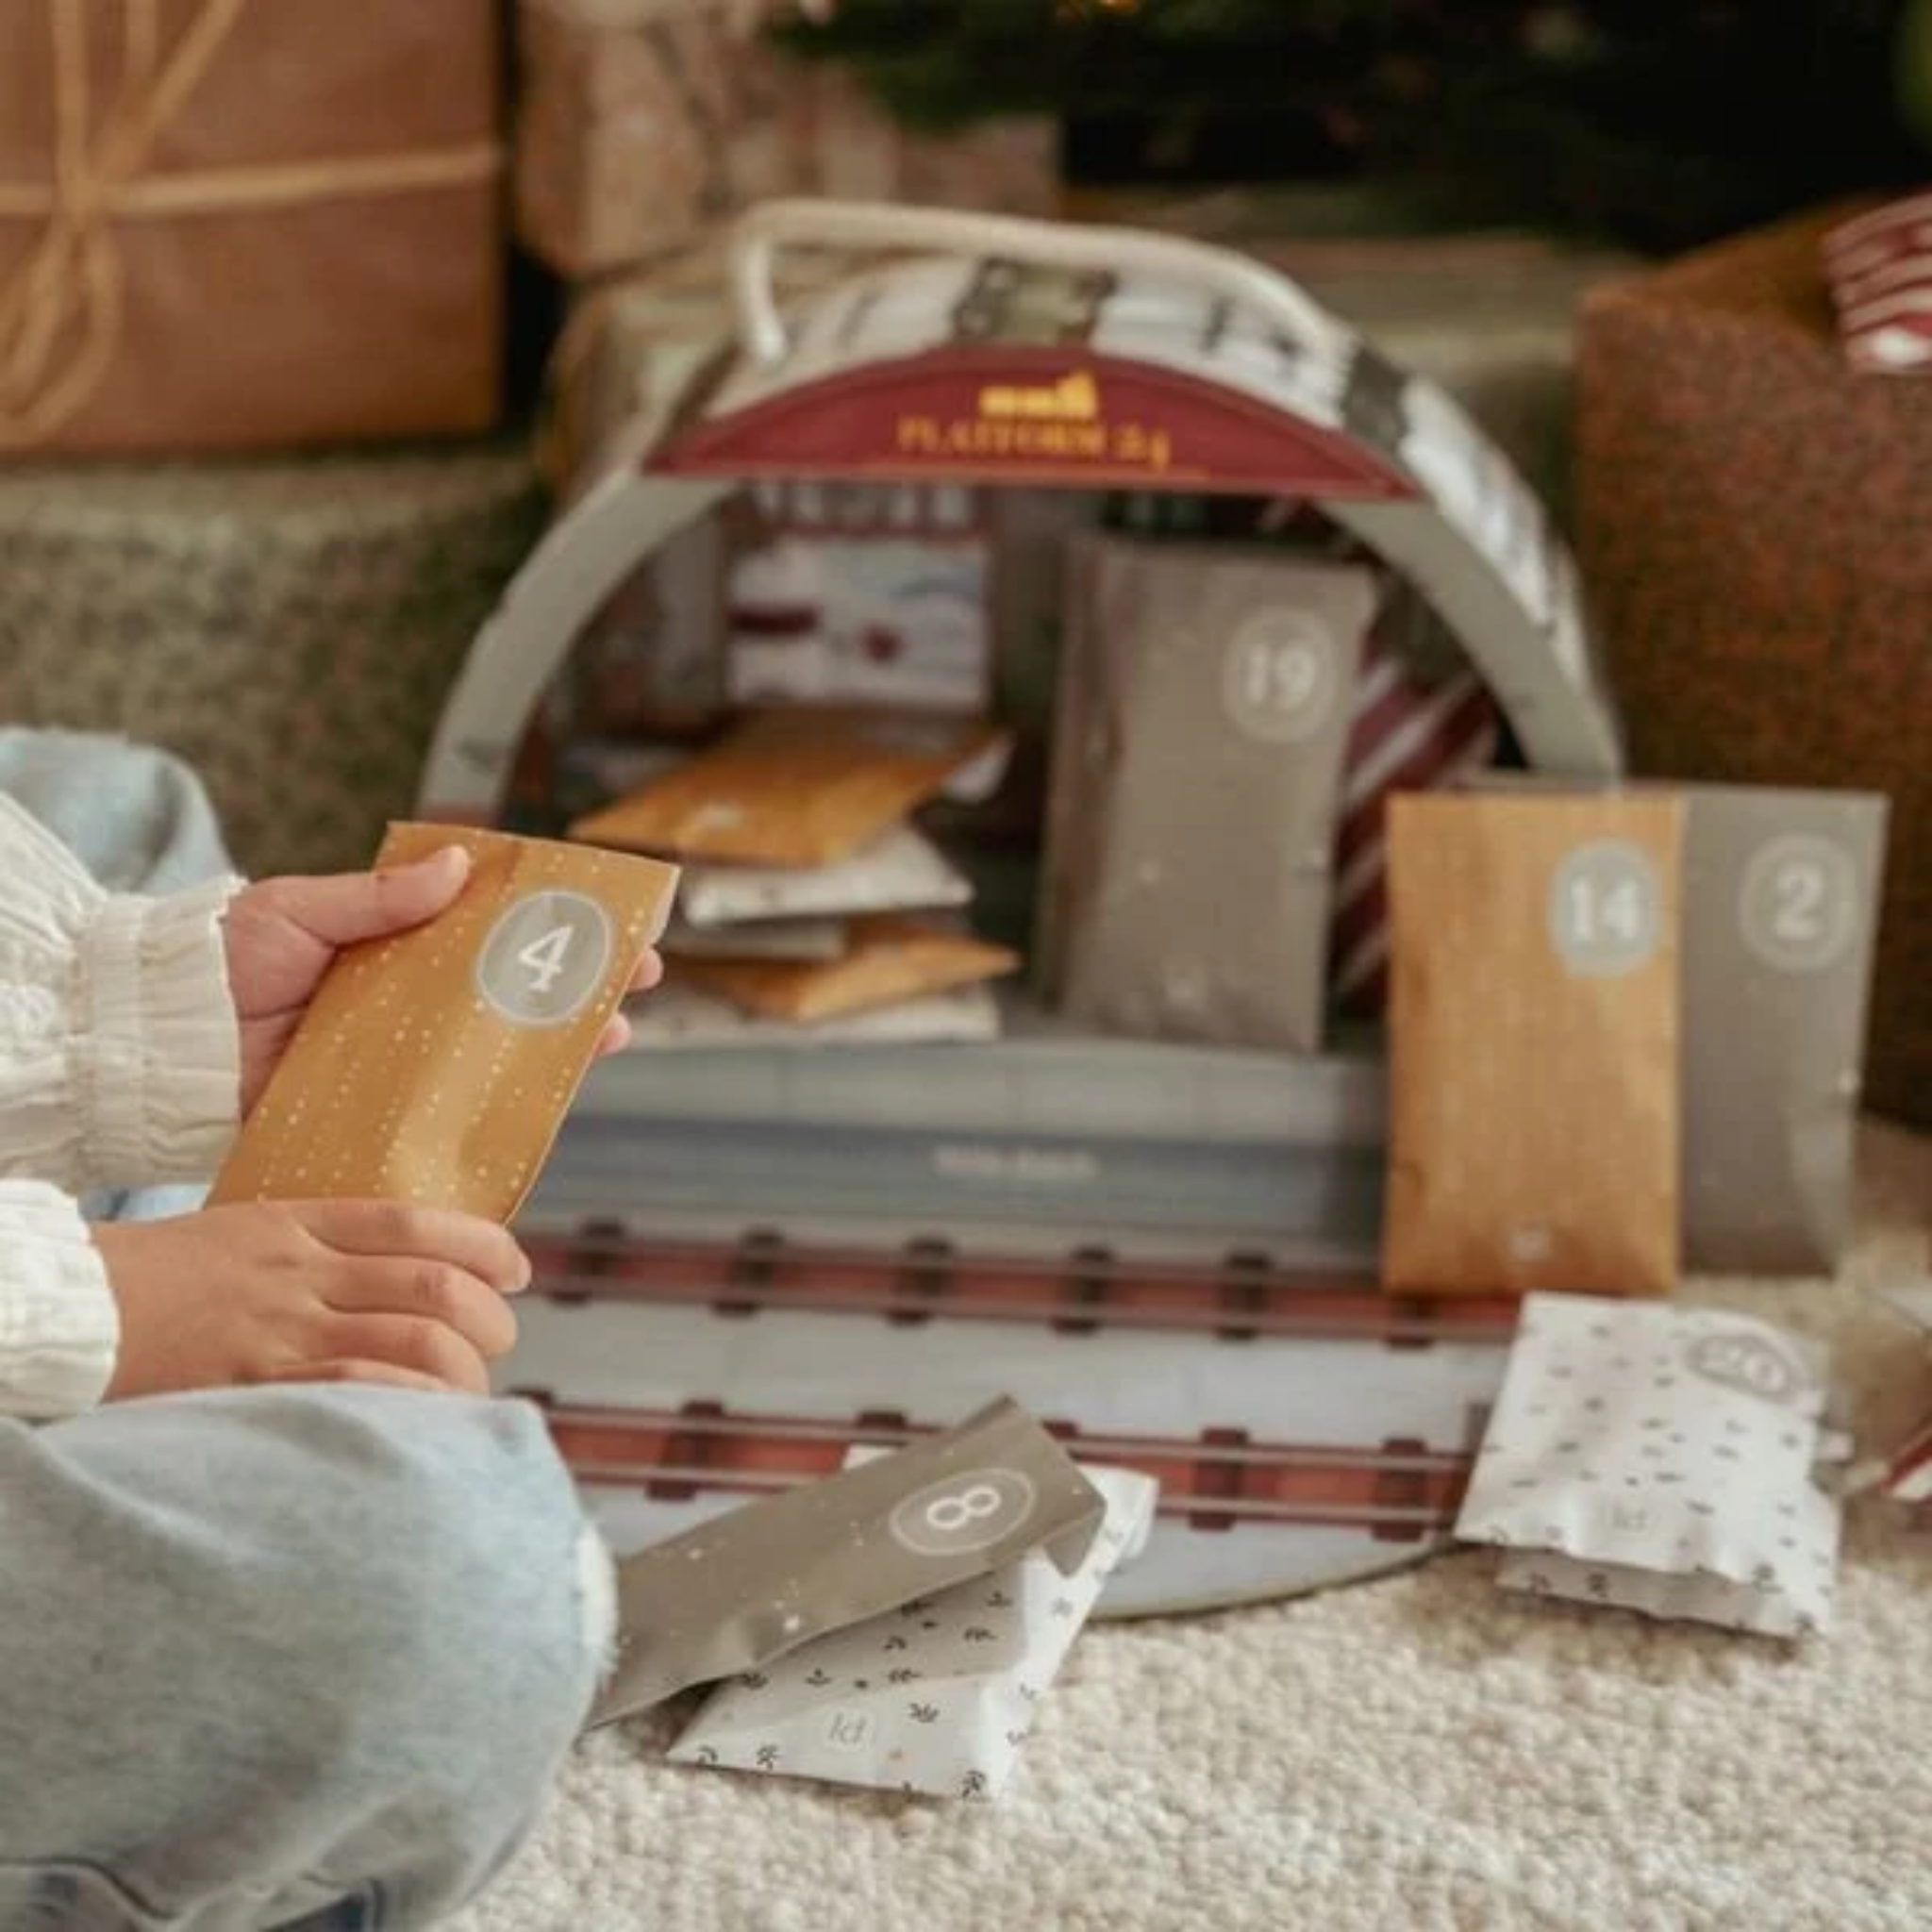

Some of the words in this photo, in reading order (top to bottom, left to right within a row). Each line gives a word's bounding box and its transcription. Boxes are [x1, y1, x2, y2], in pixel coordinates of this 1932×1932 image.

[1247, 642, 1316, 708] 19
[1569, 875, 1638, 941] 14
[1774, 862, 1824, 941] 2
[518, 924, 574, 992] 4
[926, 1486, 1002, 1530] 8
